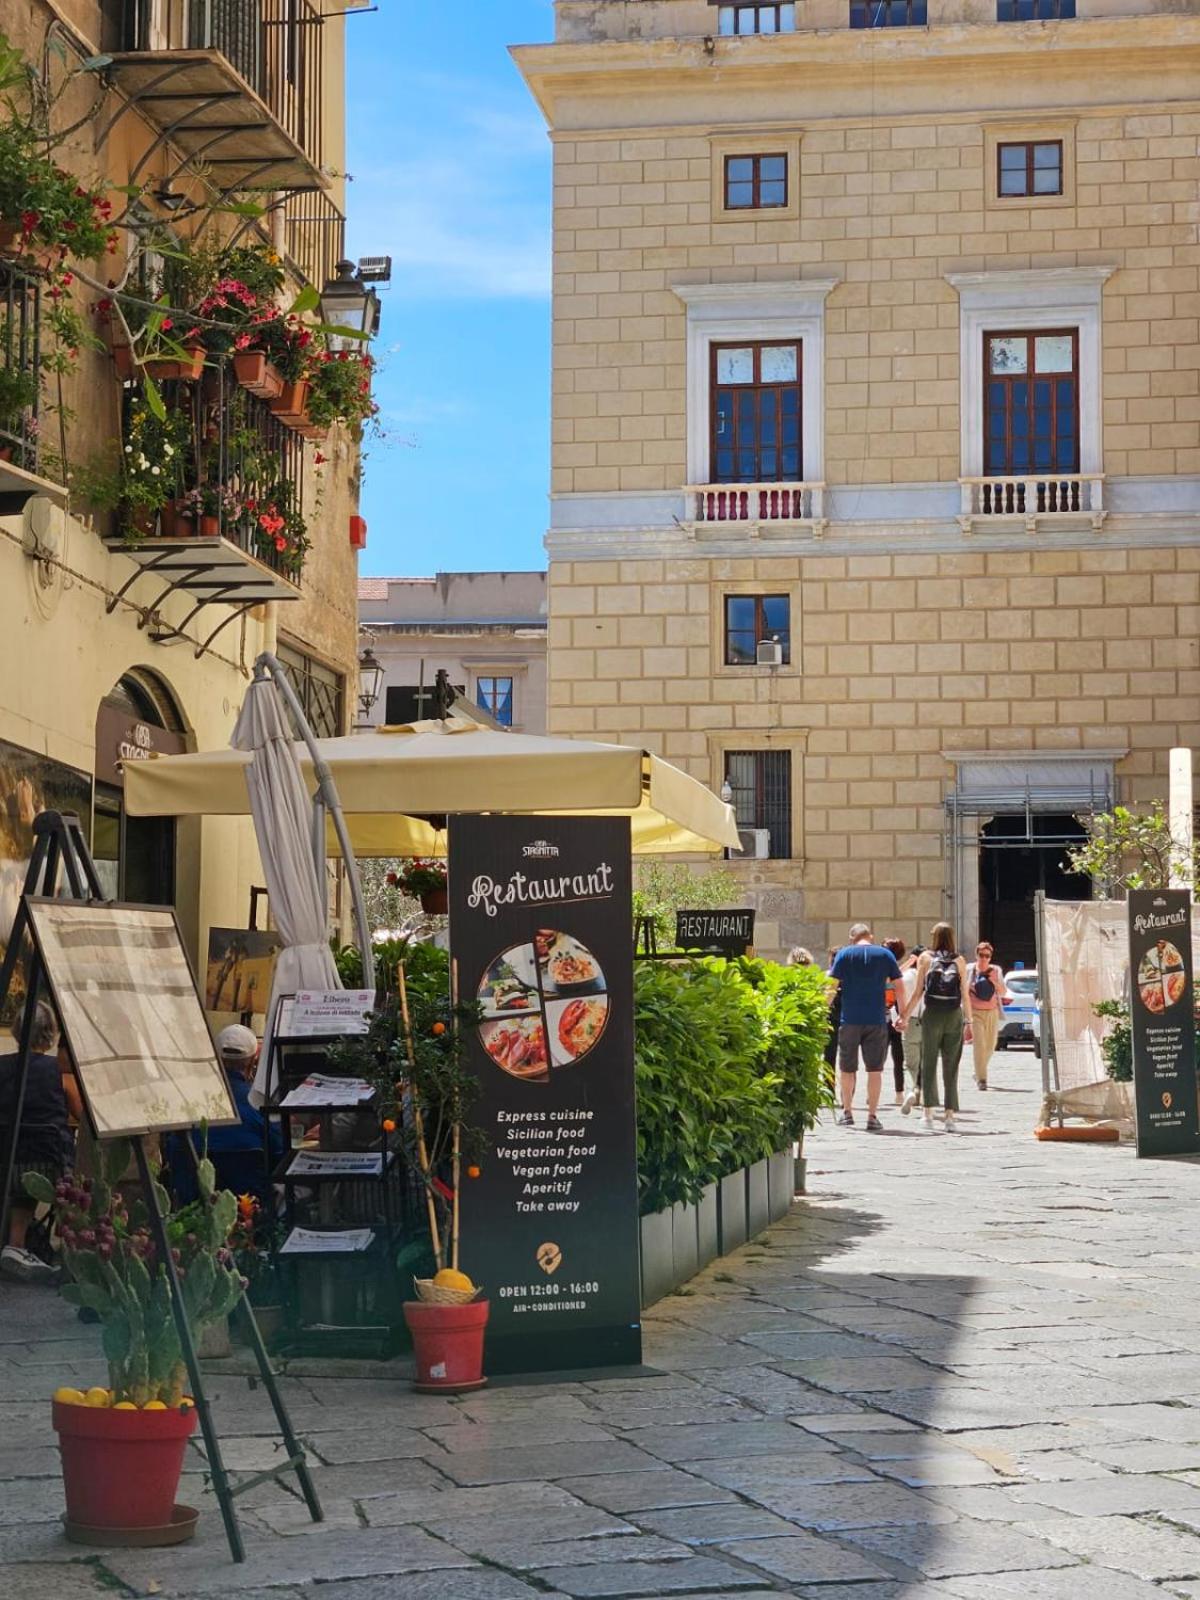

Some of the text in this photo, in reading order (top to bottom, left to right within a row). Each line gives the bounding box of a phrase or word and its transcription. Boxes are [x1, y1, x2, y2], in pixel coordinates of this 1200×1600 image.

[467, 862, 614, 917] Restaurant
[681, 915, 750, 938] RESTAURANT
[1134, 907, 1186, 935] Restaurant
[497, 1109, 594, 1123] Express cuisine
[507, 1127, 585, 1141] Sicilian food
[496, 1144, 597, 1160] Vegetarian food
[512, 1163, 582, 1178] Vegan food
[522, 1181, 572, 1195] Aperitif
[515, 1201, 580, 1212] Take away
[499, 1286, 527, 1297] OPEN
[530, 1284, 559, 1296] 12:00
[570, 1281, 599, 1294] 16:00
[513, 1301, 586, 1313] AIR-CONDITIONED
